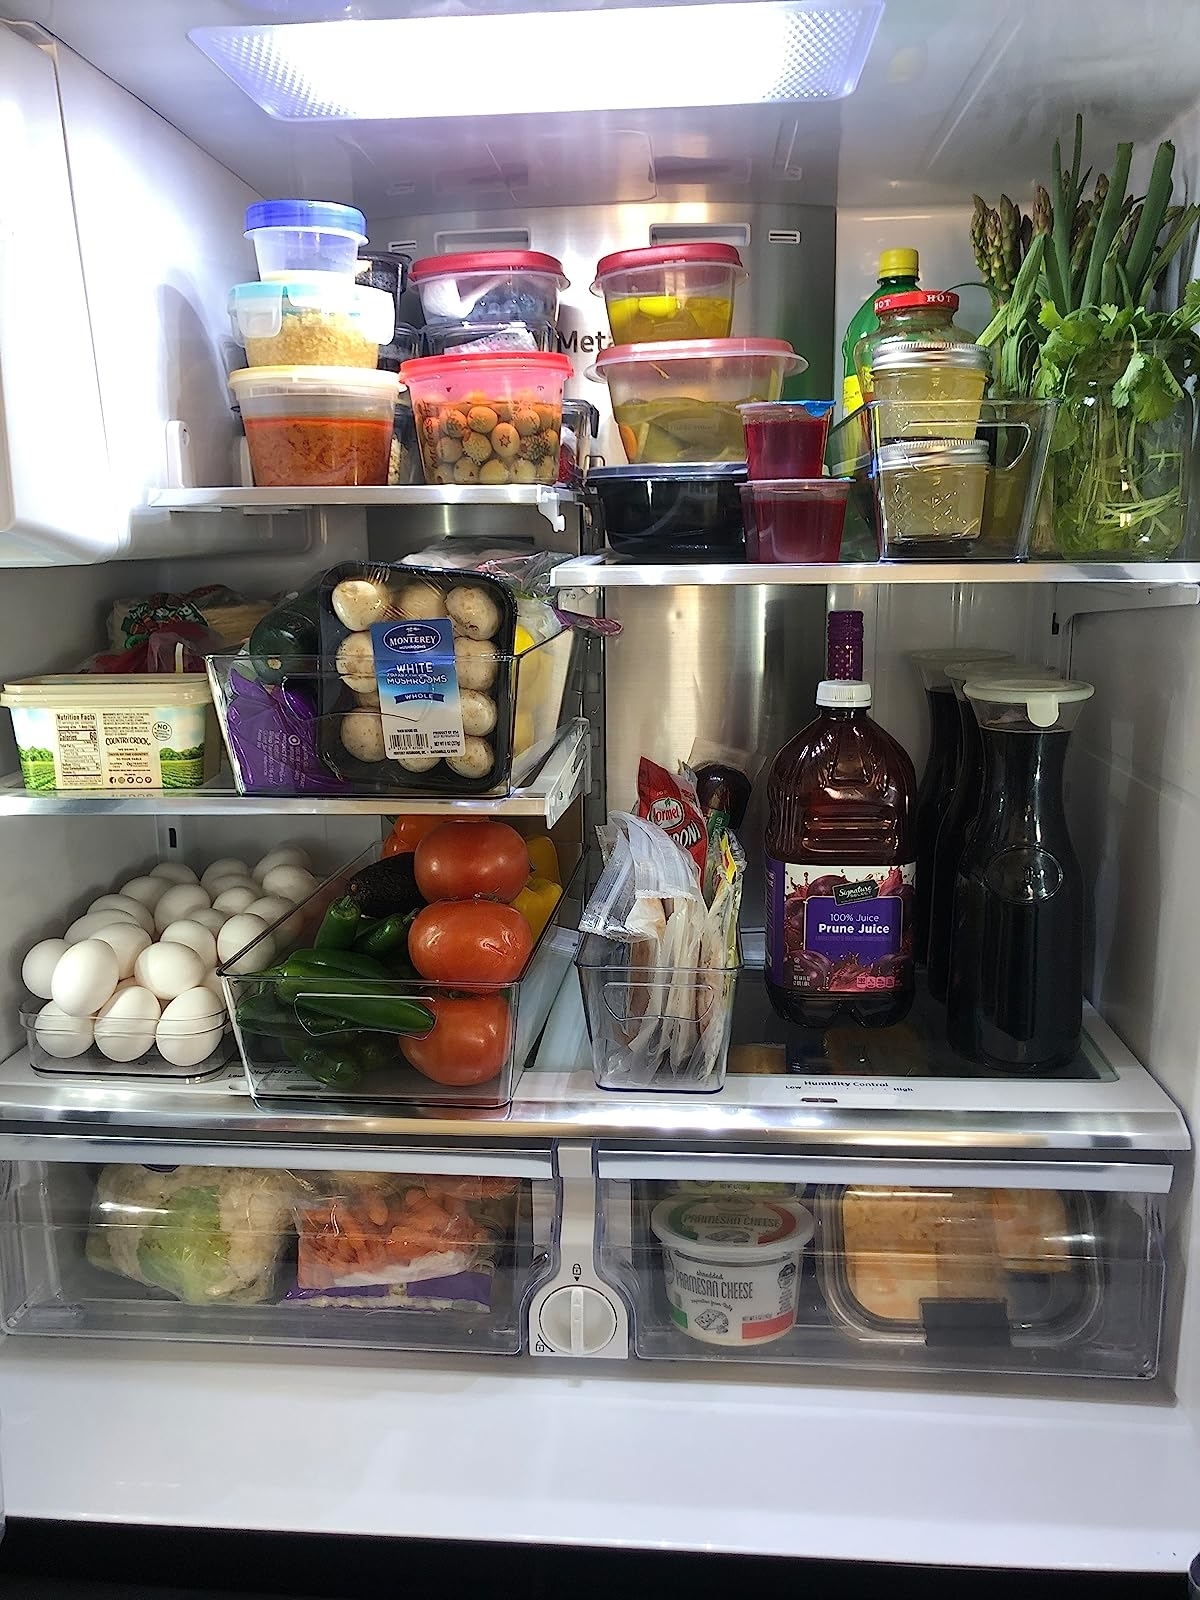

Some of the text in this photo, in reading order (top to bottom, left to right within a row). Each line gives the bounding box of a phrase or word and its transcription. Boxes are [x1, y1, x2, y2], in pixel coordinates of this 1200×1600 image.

[926, 294, 952, 303] HOT
[389, 635, 436, 647] MONTEREY
[396, 661, 433, 674] WHITE
[386, 674, 447, 685] MUSHROOMS
[56, 713, 80, 721] Nutrition
[81, 713, 96, 721] Facts
[105, 737, 129, 746] COUNTRY
[838, 885, 872, 899] Signature
[830, 913, 880, 922] 100% Juice
[818, 923, 890, 934] Prune Juice
[683, 1213, 781, 1228] PARMESAN CHEESE
[675, 1269, 754, 1299] PARMESAN CHEESE
